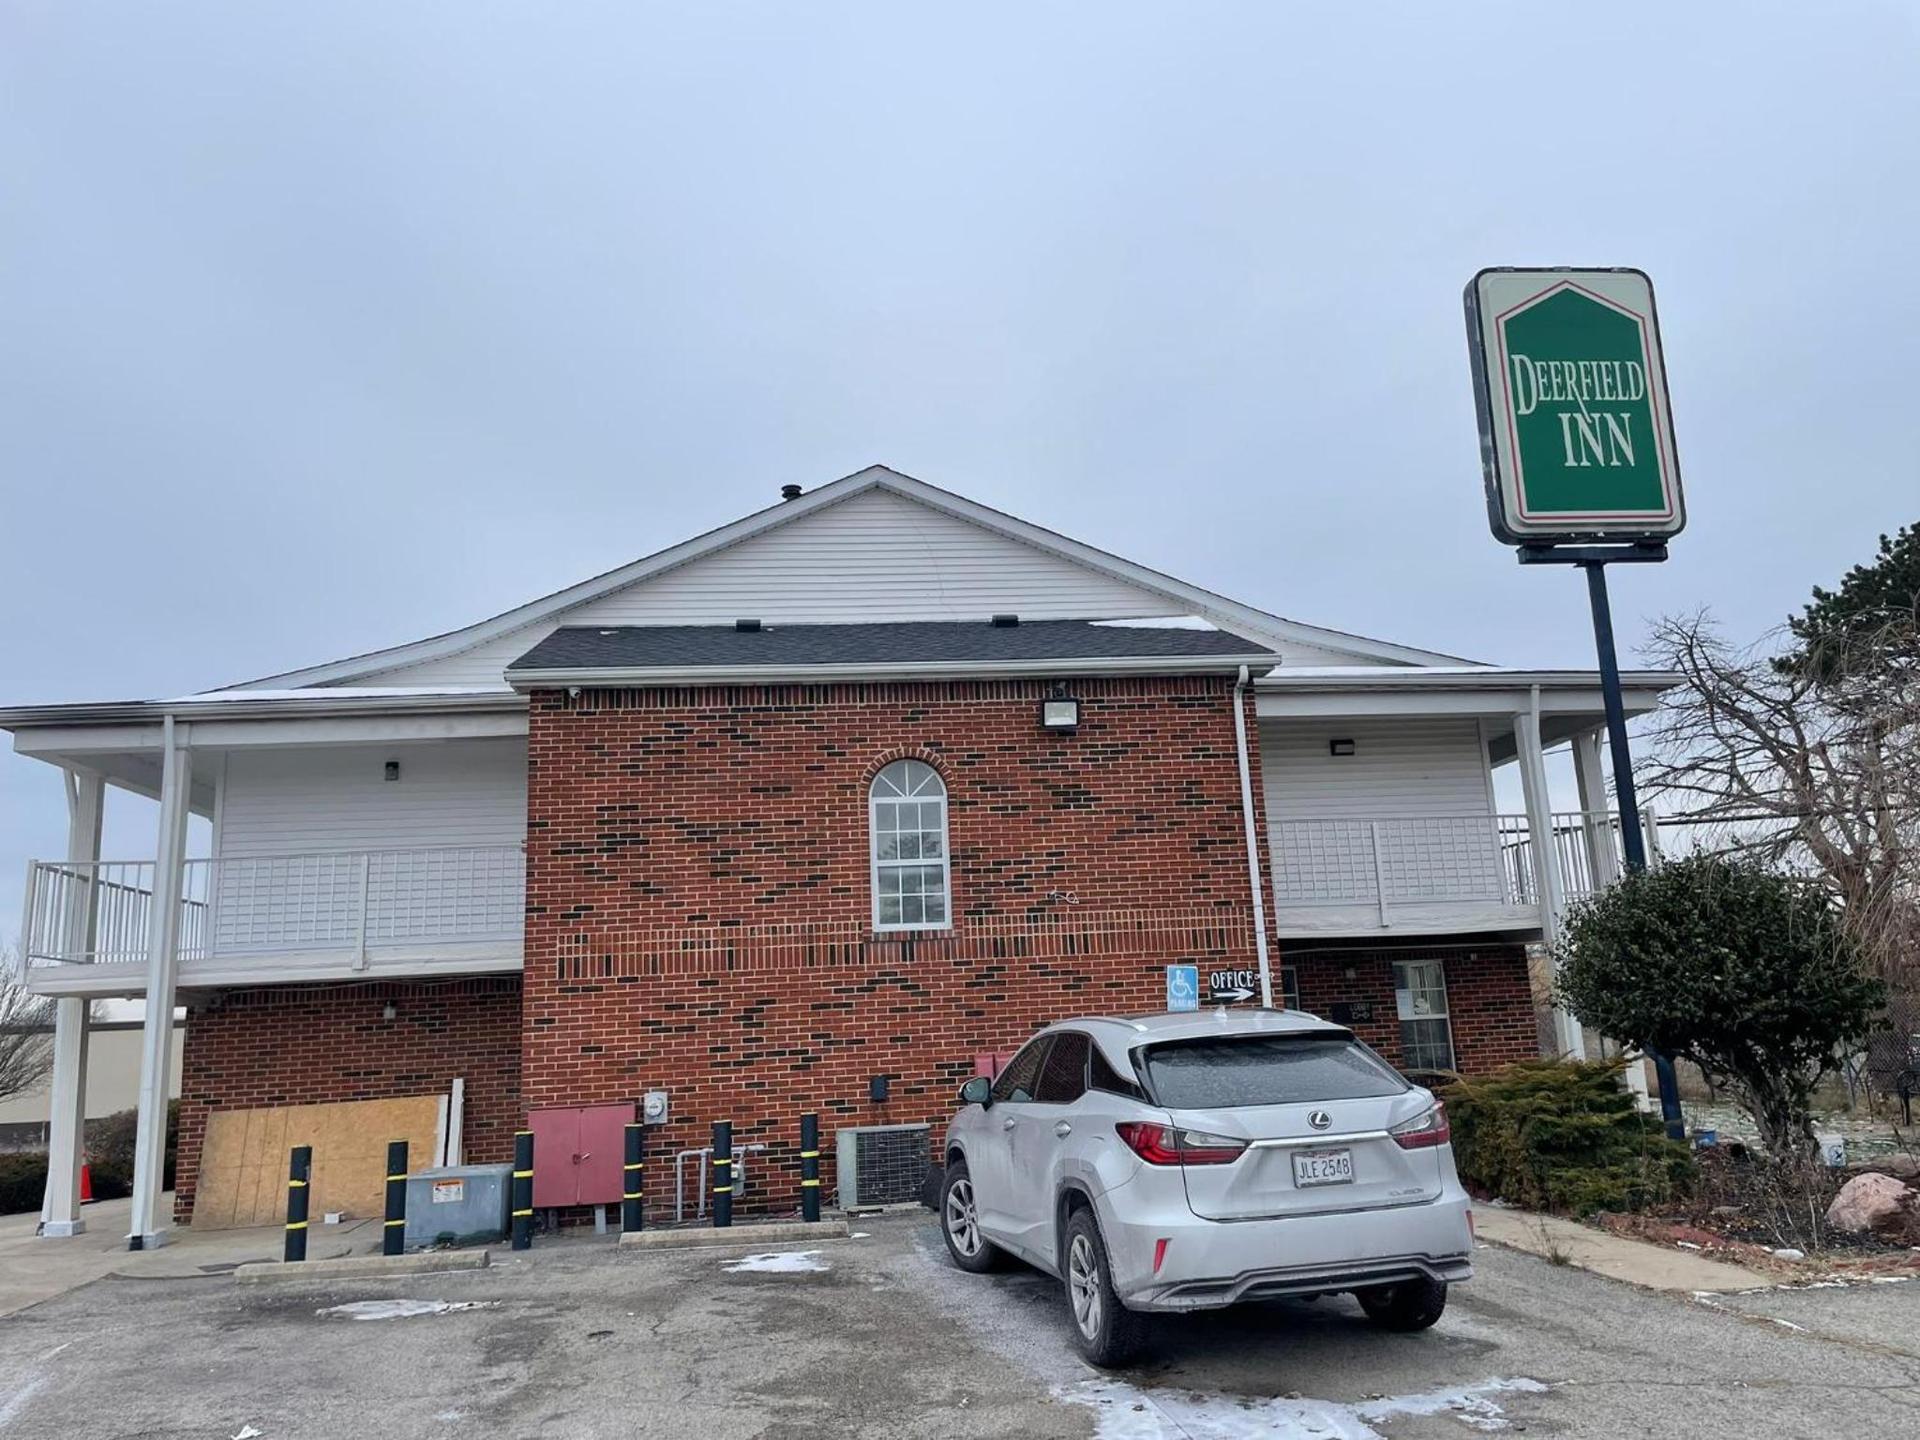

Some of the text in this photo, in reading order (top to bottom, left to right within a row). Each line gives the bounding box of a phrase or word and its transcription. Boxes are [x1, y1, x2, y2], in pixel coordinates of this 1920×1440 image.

[1511, 353, 1645, 423] DEERFIELD
[1558, 412, 1636, 467] INN
[1210, 970, 1255, 989] OFFICE
[1300, 1158, 1350, 1179] JLE 2548
